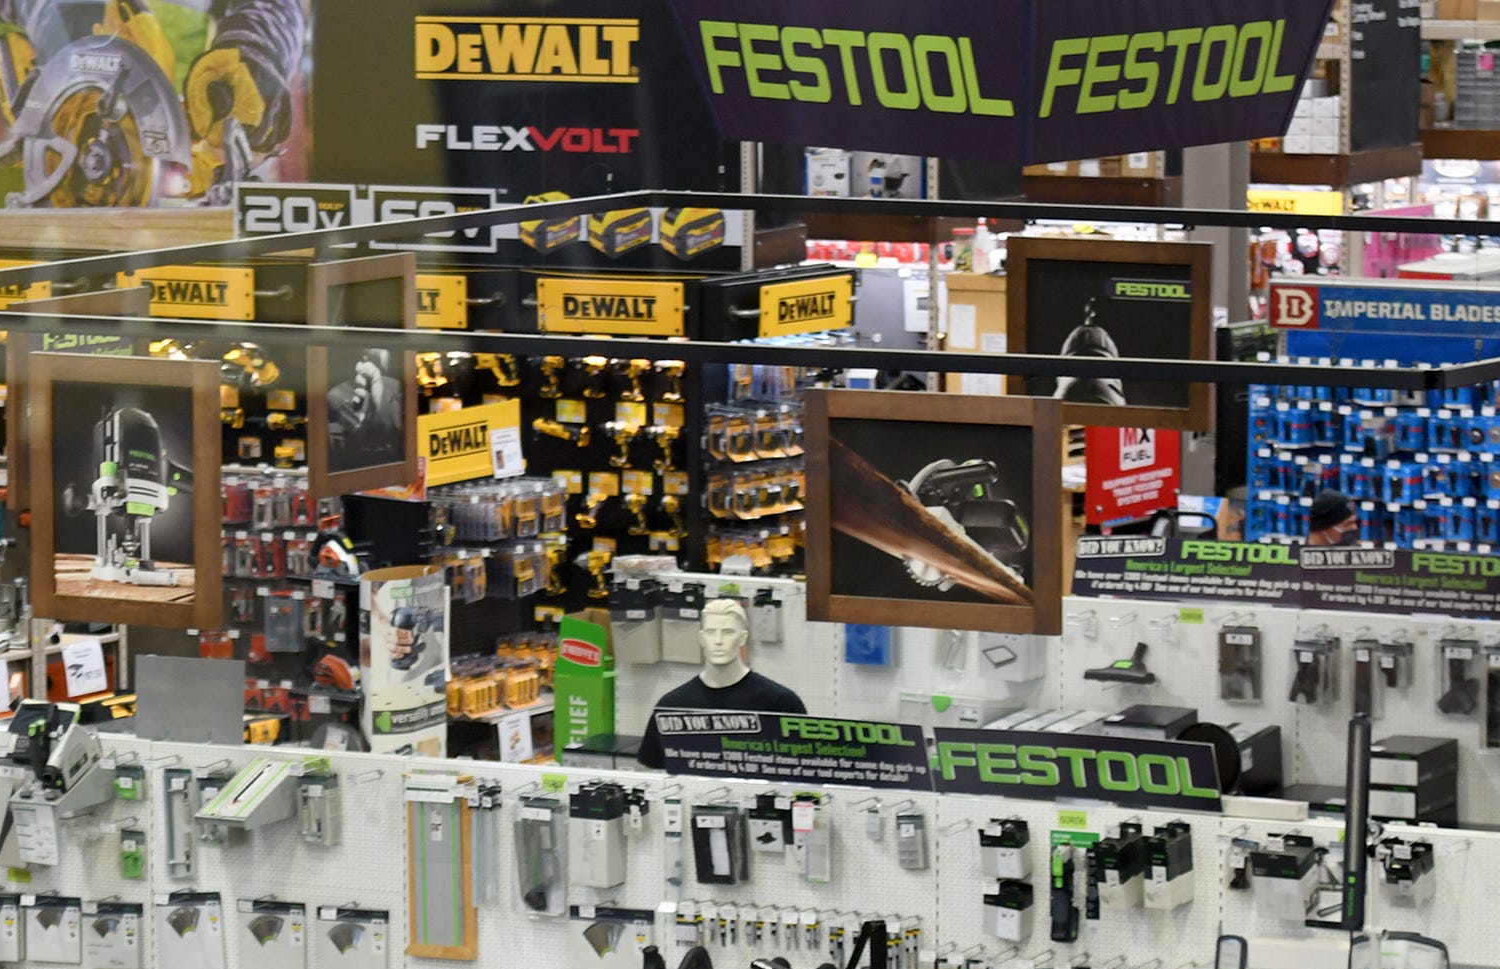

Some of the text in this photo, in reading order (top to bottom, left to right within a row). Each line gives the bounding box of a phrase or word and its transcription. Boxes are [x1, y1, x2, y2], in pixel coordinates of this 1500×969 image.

[700, 20, 1014, 118] FESTOOL
[1038, 19, 1297, 118] FESTOOL
[417, 124, 640, 153] FLEXVOLT
[1115, 282, 1191, 299] FESTOOL
[1323, 299, 1500, 324] IMPERIAL BLADES
[1123, 449, 1152, 462] FUEL
[1181, 540, 1299, 565] FESTOOL
[659, 713, 758, 733] DID YOU KNOW?
[779, 717, 916, 747] FESTOOL
[938, 741, 1220, 799] FESTOOL
